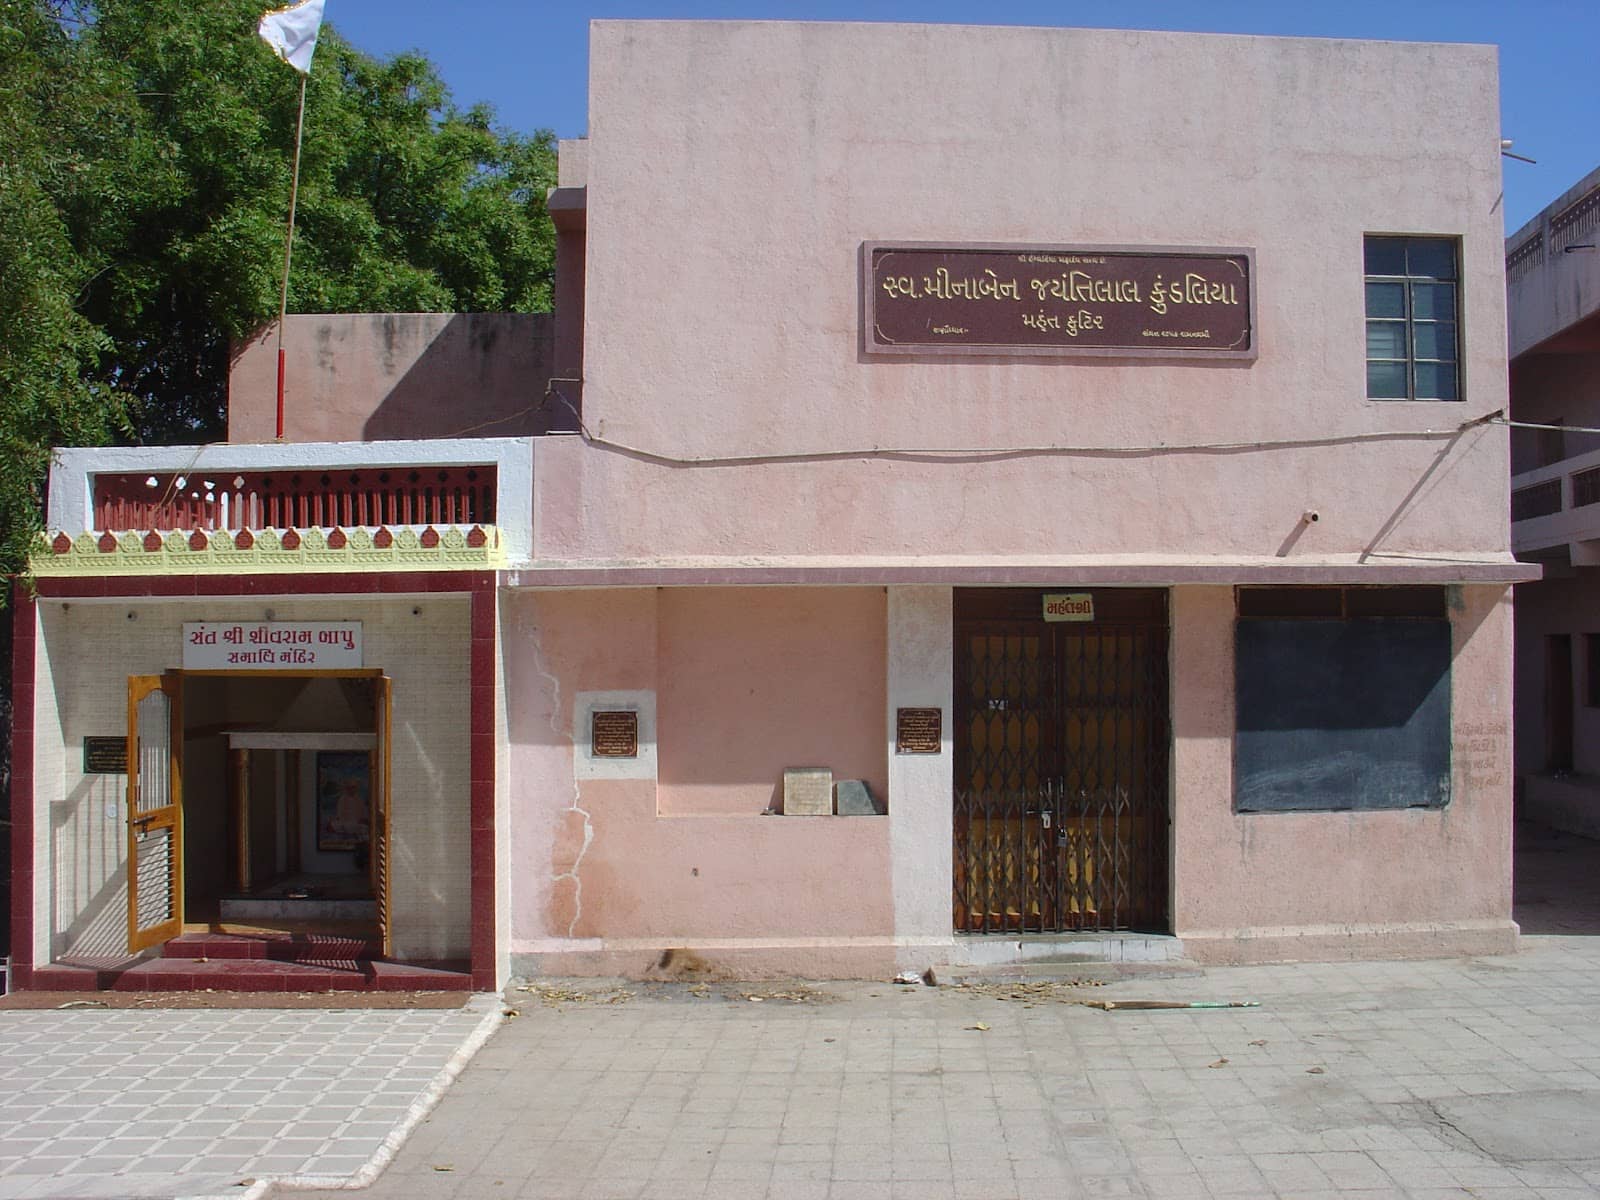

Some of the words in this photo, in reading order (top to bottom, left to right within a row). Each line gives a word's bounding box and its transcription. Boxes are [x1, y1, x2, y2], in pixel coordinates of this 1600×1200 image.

[1030, 271, 1141, 304] જયંતિલાલ
[1149, 272, 1239, 315] કુંડલિયા
[1022, 308, 1061, 332] મહંત
[1065, 309, 1105, 337] કુટિર
[190, 626, 217, 645] સંત
[223, 626, 243, 645] શ્રી
[249, 626, 312, 645] શીવરામ
[319, 629, 356, 650] બાપુ
[227, 648, 275, 664] સમાધિ
[280, 647, 316, 664] મંદિર
